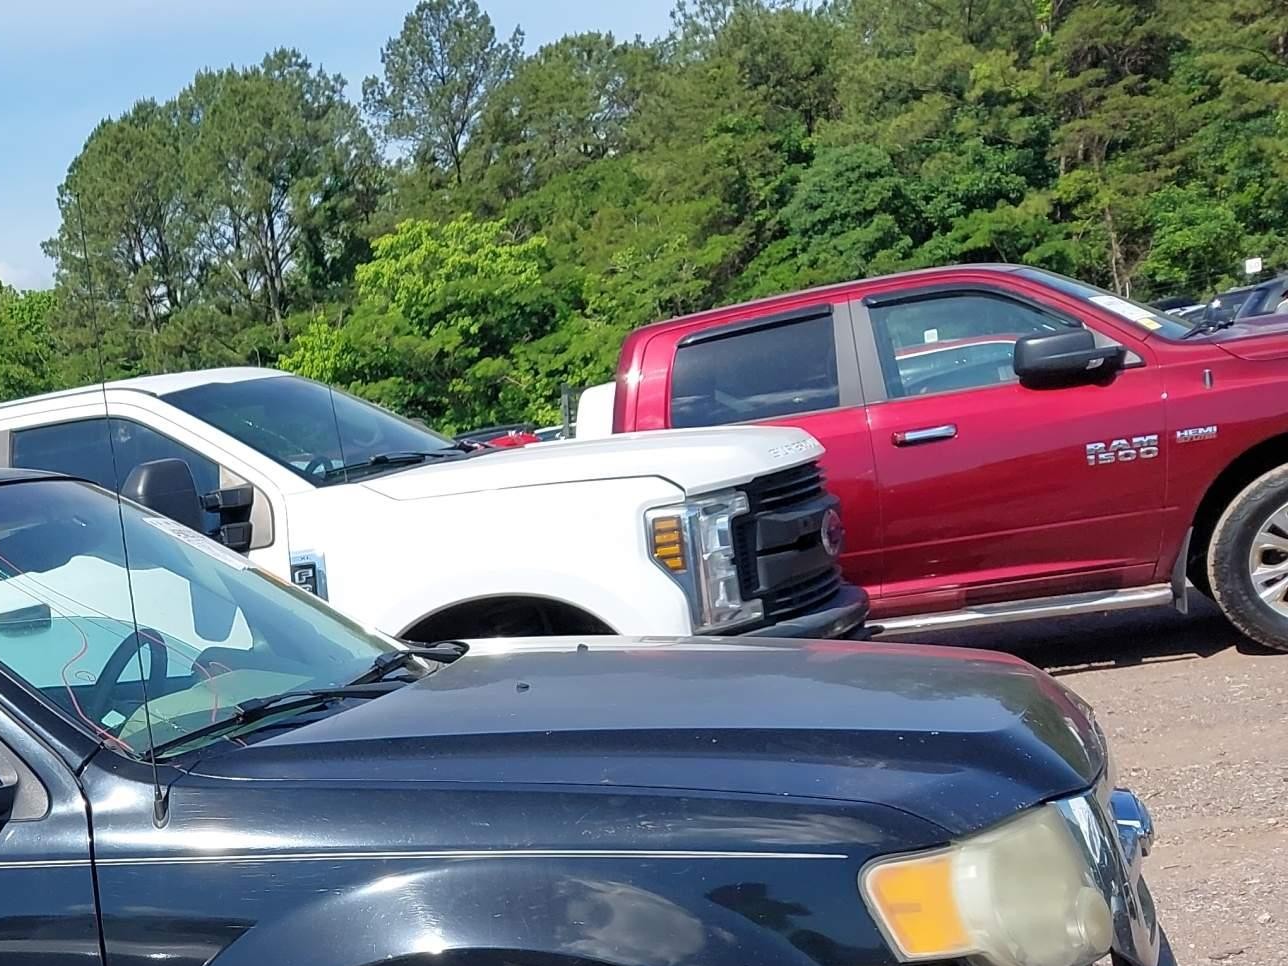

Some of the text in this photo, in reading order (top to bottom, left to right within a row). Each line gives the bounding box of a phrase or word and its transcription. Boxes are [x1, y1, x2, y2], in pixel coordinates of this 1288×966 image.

[1176, 426, 1217, 439] HEMI
[1085, 434, 1159, 456] RAM
[1086, 446, 1159, 466] 1500
